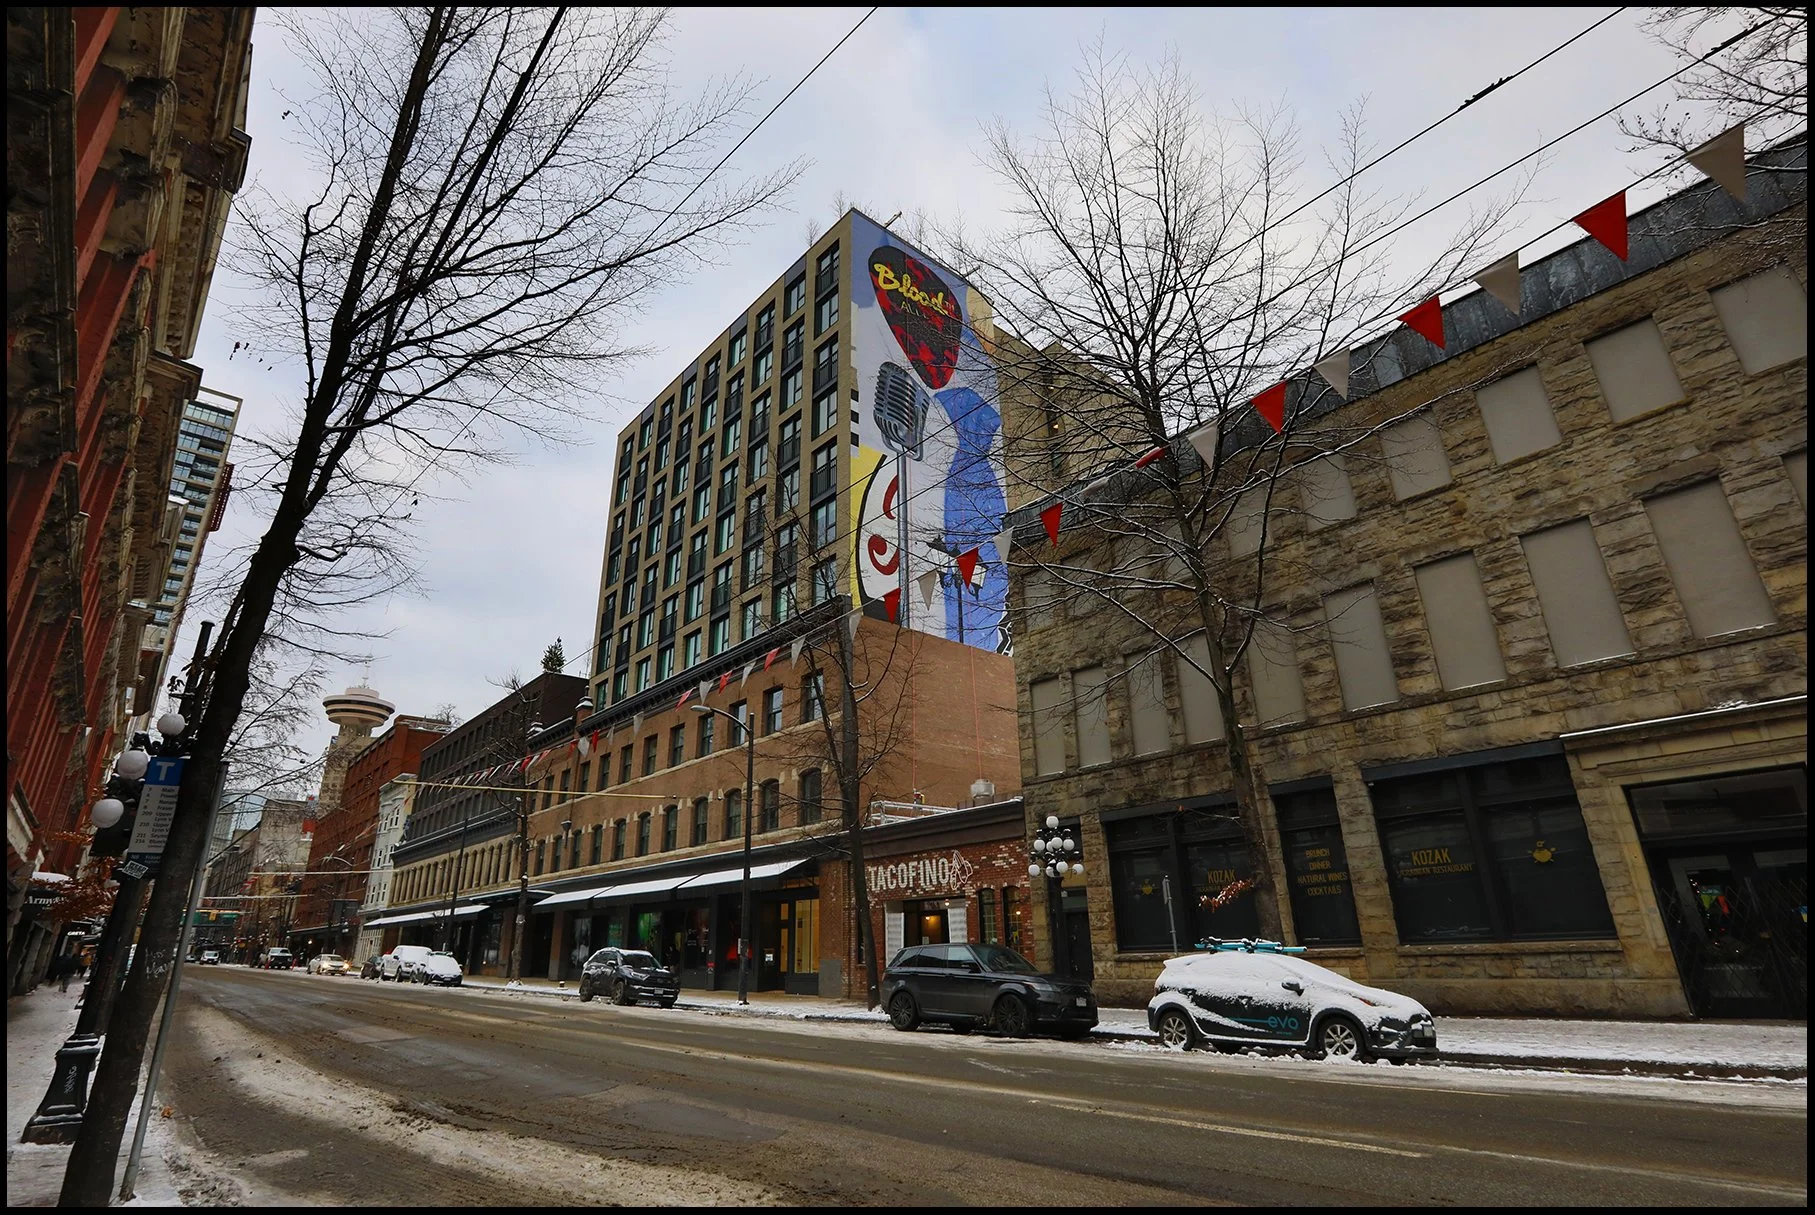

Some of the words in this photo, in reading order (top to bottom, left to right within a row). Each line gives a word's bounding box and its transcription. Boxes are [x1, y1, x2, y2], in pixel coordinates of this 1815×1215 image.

[155, 760, 177, 781] T
[1411, 848, 1452, 866] KOZAK
[868, 857, 950, 891] TACOFINO
[1207, 868, 1237, 884] KOZAK
[1267, 1015, 1300, 1031] evo
